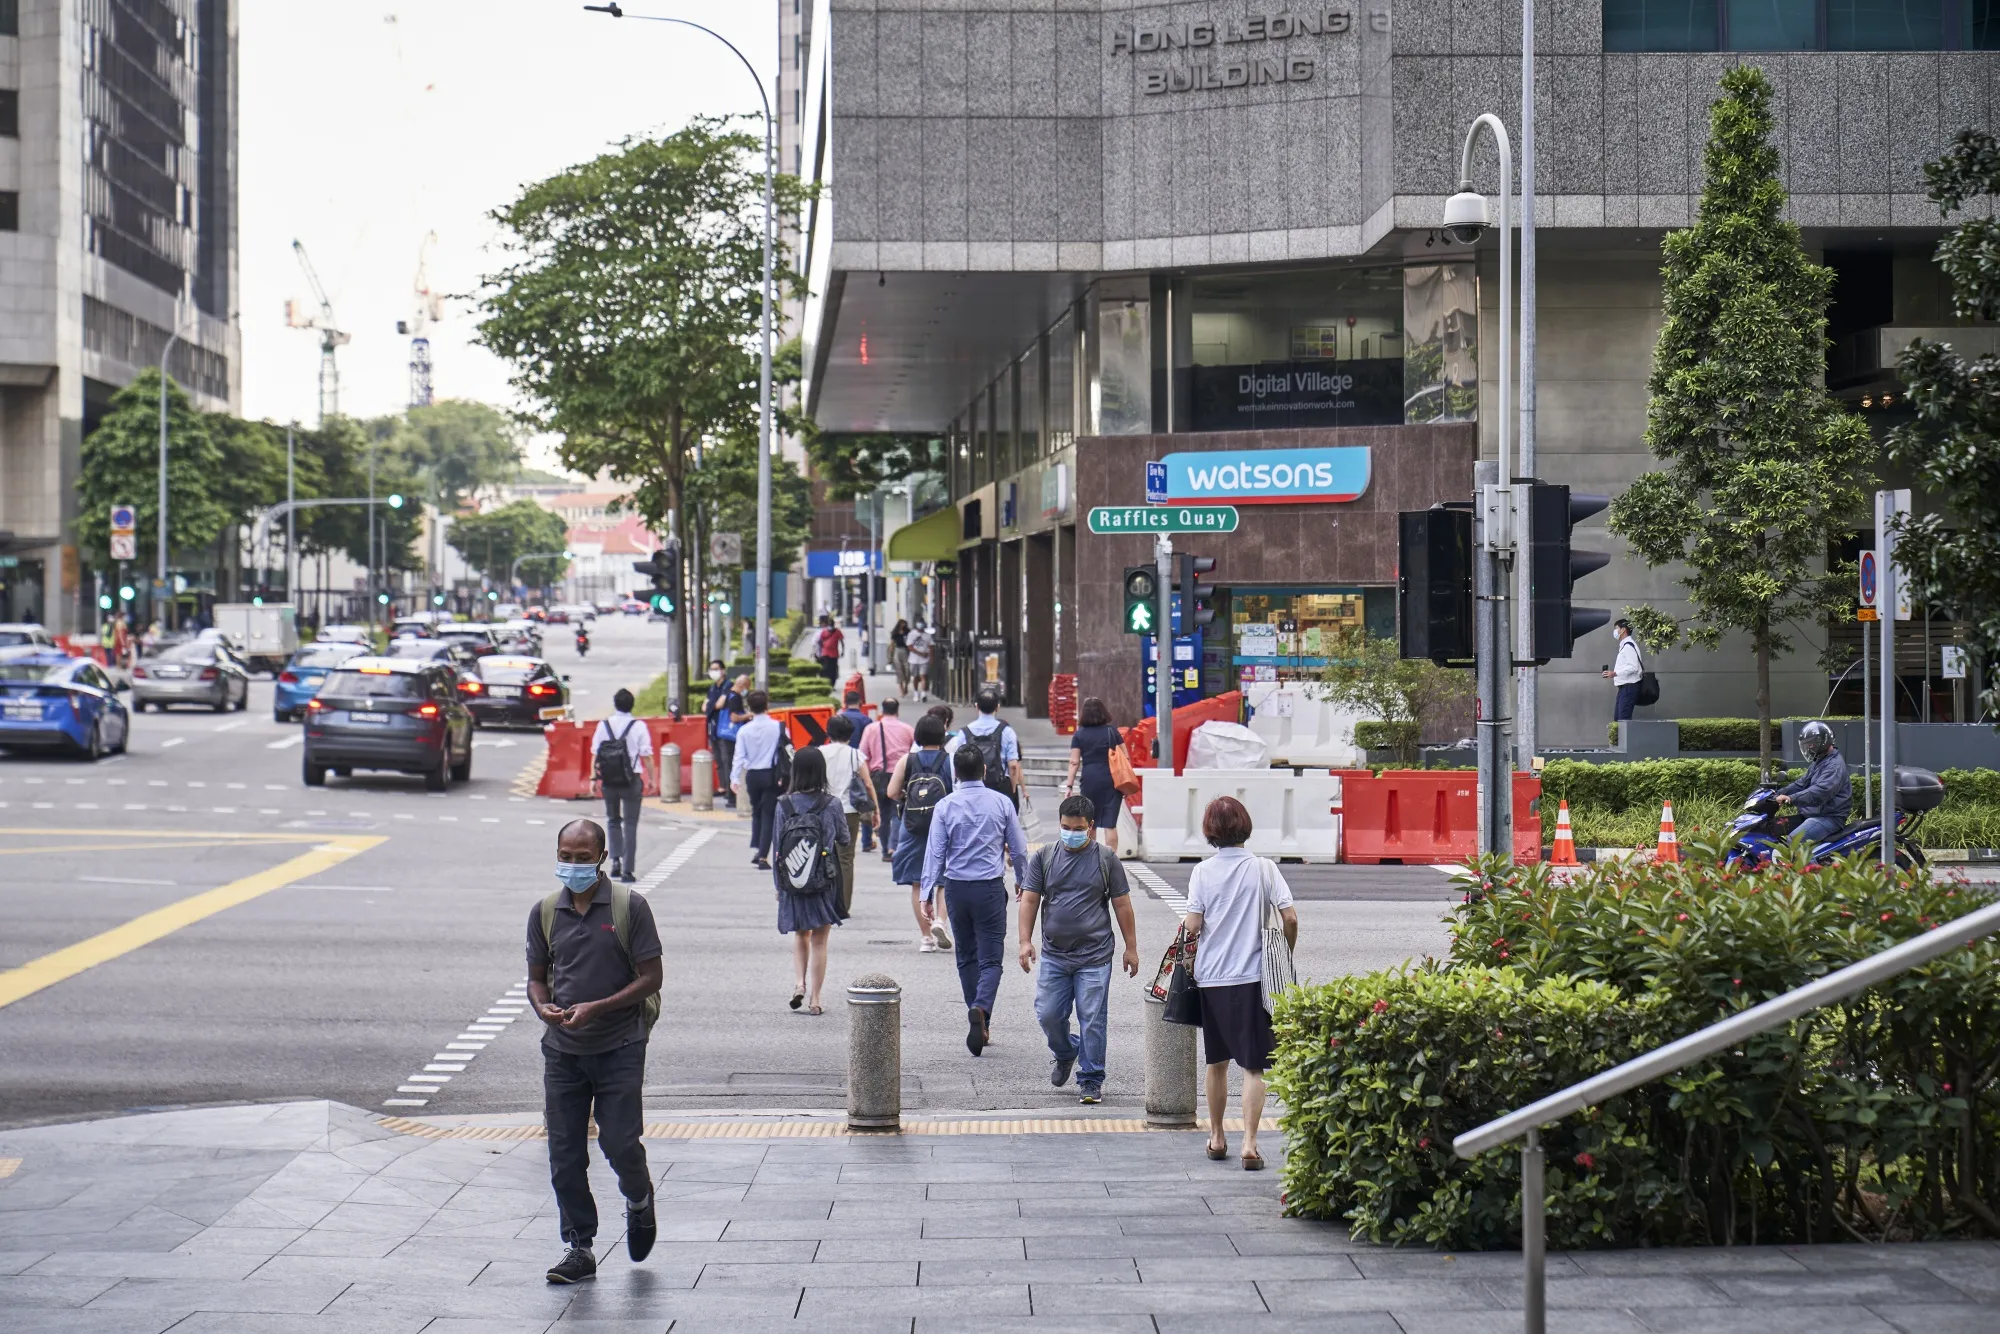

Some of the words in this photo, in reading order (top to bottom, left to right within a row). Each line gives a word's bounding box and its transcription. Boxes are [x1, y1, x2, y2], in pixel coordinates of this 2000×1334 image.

[1110, 21, 1215, 56] HONG
[1222, 7, 1350, 45] LEONG
[1142, 55, 1314, 95] BUILDING
[1238, 373, 1290, 398] Digital
[1294, 371, 1353, 395] Village
[1237, 399, 1355, 412] wemakeinnovationwork.com
[1187, 461, 1333, 491] watsons
[1099, 510, 1168, 527] Raffles
[1179, 509, 1227, 529] Quay
[785, 838, 811, 876] NIKE
